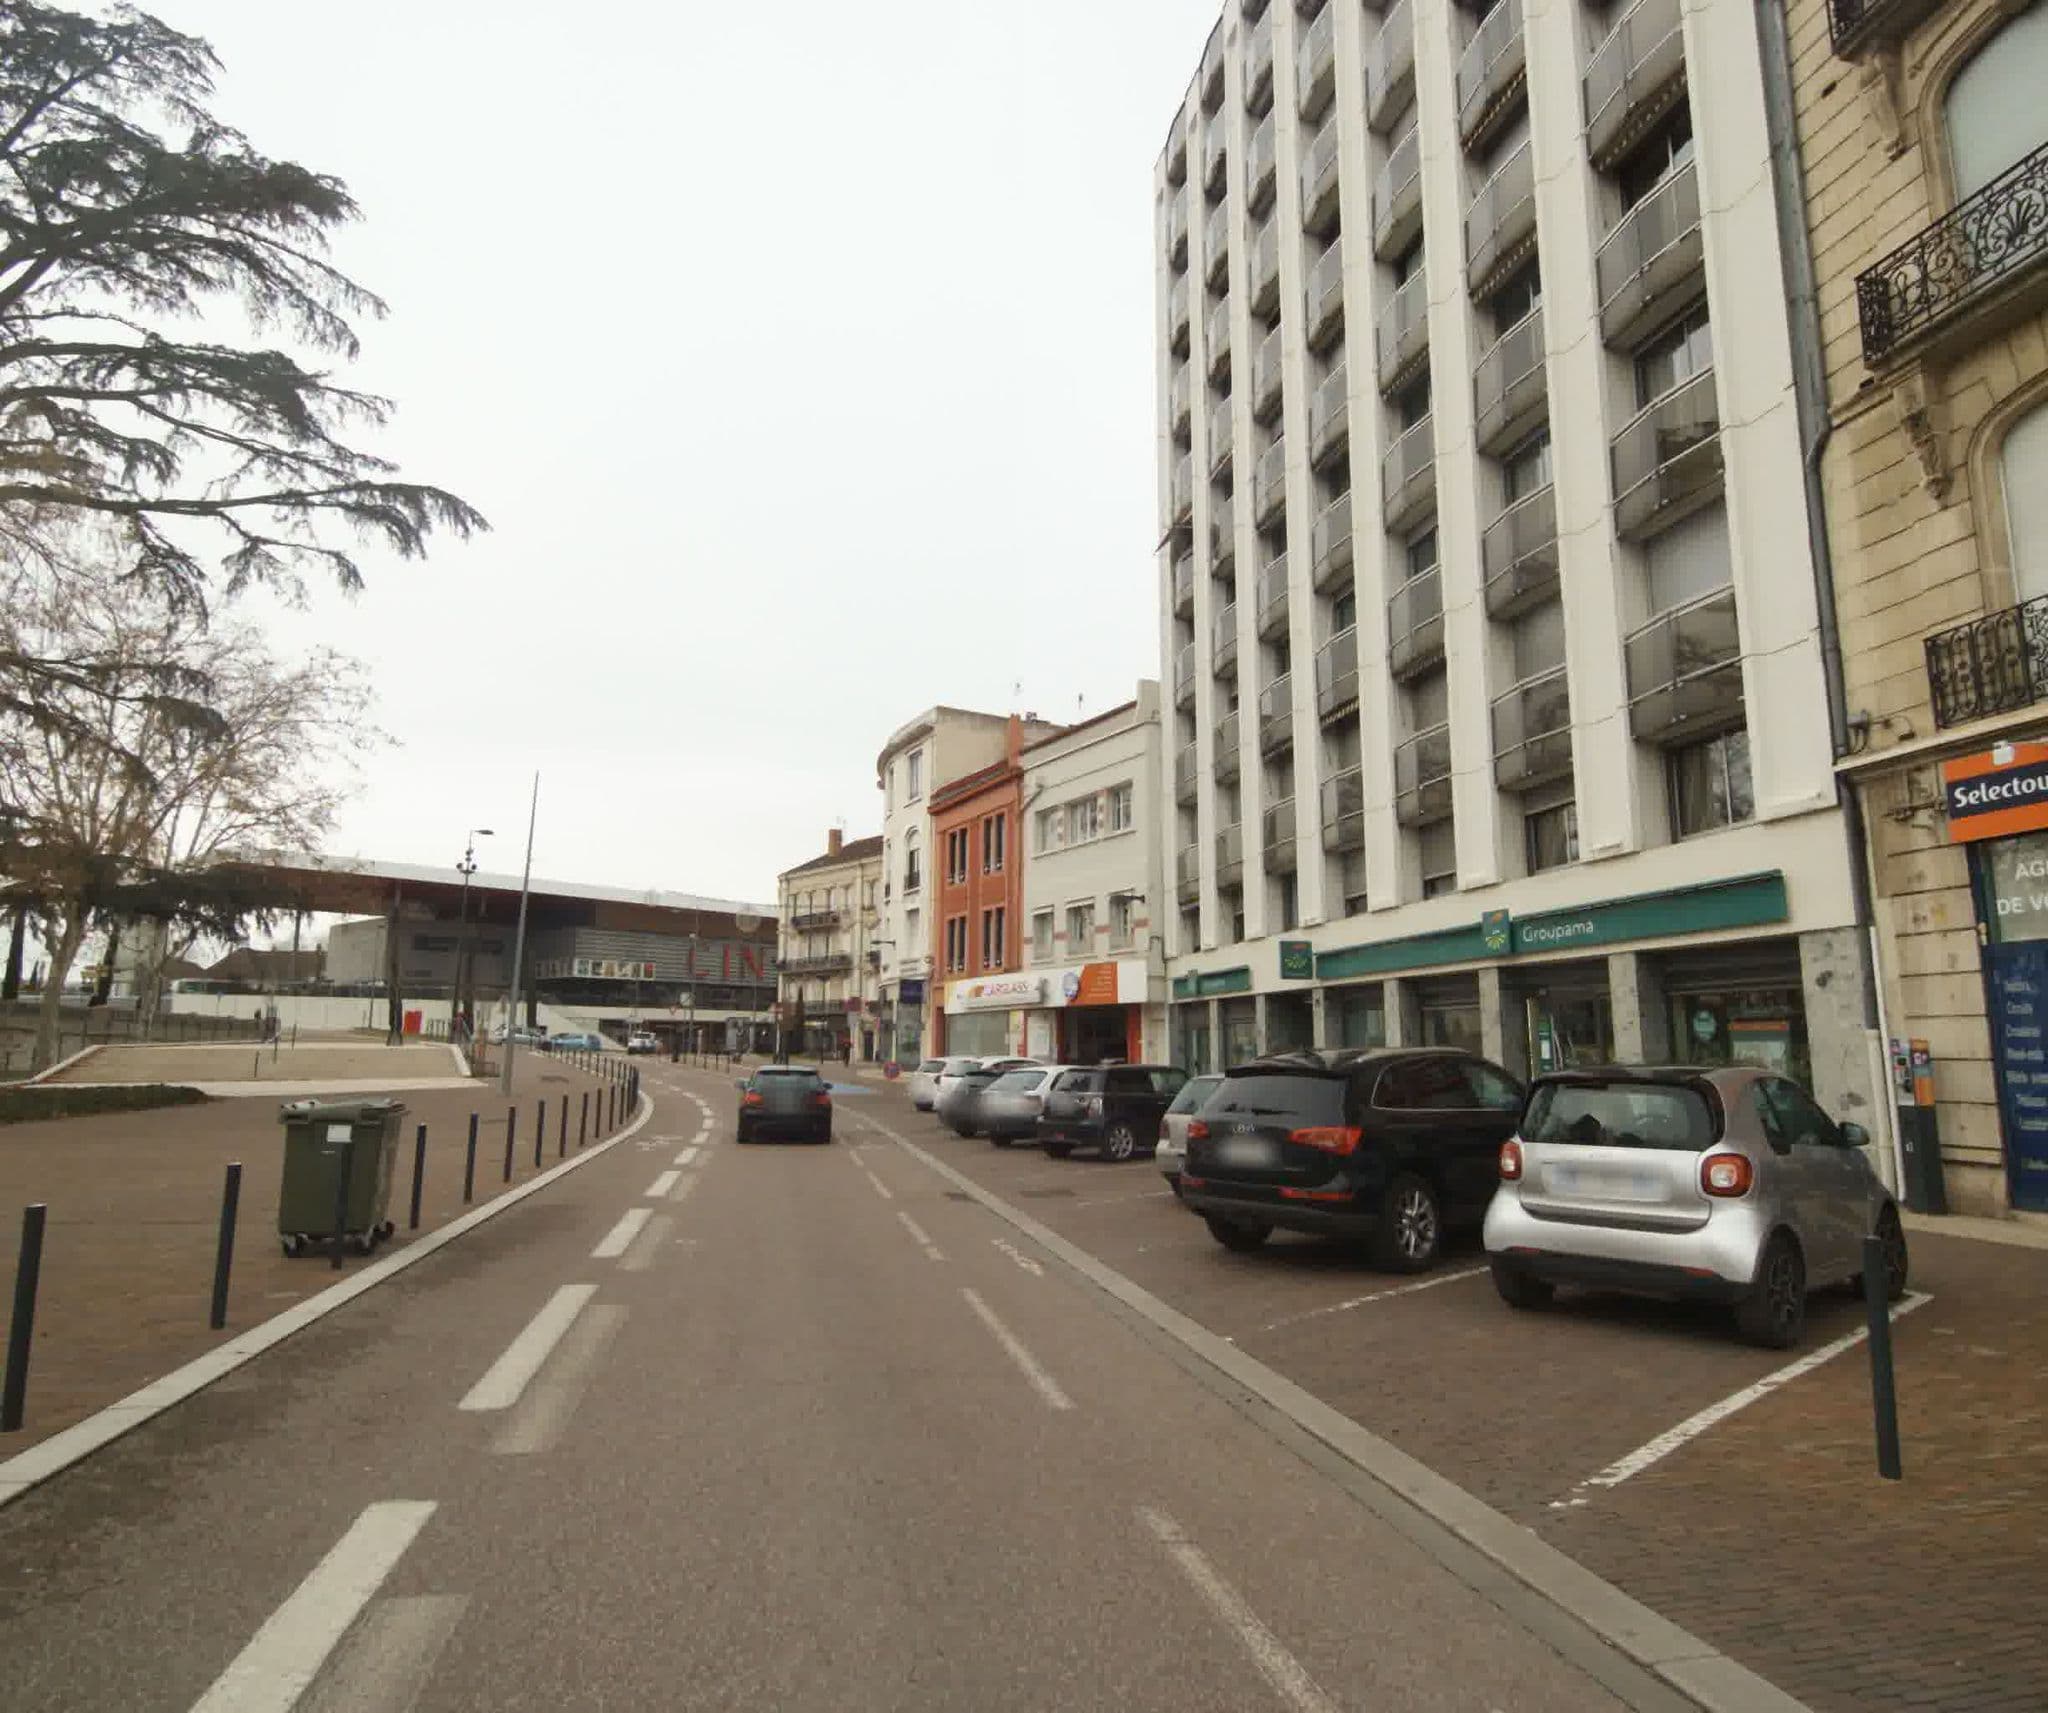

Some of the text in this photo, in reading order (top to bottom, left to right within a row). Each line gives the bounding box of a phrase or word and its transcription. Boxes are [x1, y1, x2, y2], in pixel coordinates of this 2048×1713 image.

[2015, 860, 2048, 881] AG
[1997, 893, 2048, 915] DE V
[1522, 920, 1594, 943] Groupama
